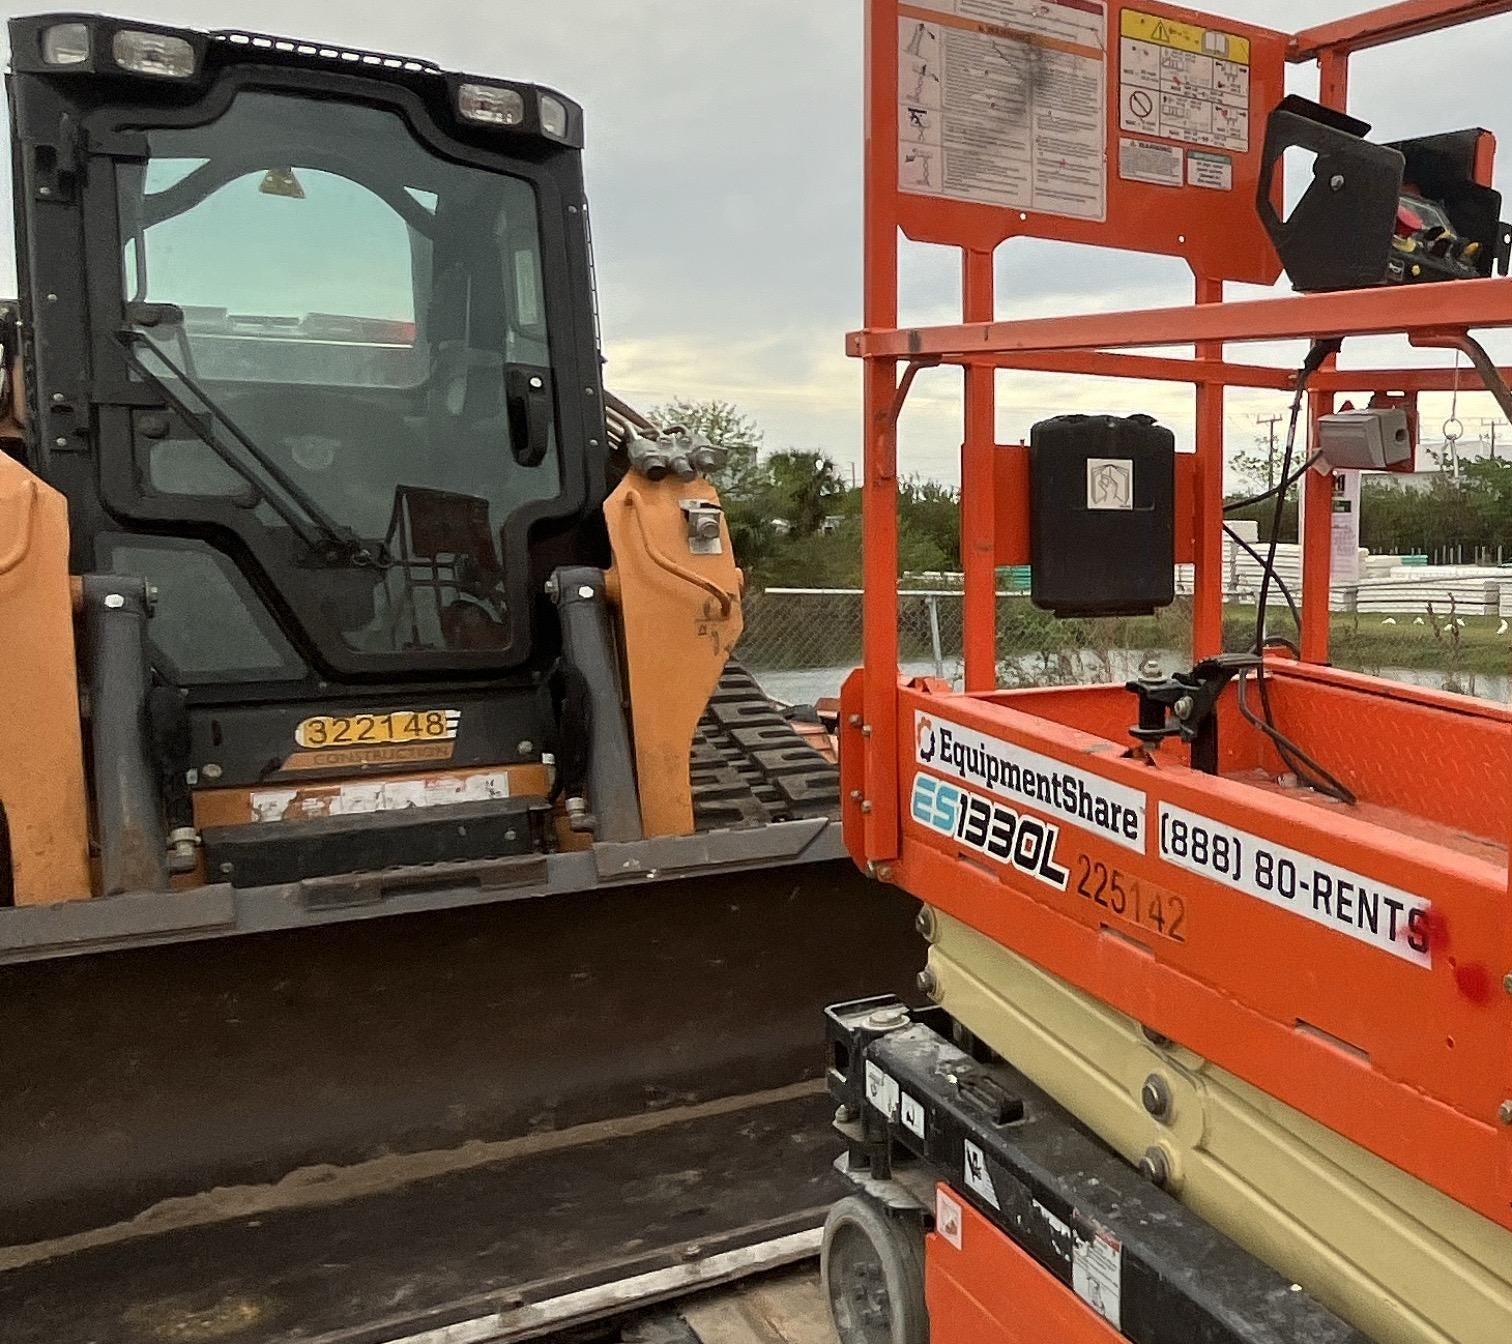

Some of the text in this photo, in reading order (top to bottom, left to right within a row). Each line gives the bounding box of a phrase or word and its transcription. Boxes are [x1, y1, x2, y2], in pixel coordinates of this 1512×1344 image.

[307, 712, 445, 745] 322148
[939, 727, 1139, 841] EquipmentShare
[912, 774, 1067, 887] ES1330L
[1161, 812, 1430, 954] (888) 80-RENTS
[1078, 854, 1185, 943] 225142
